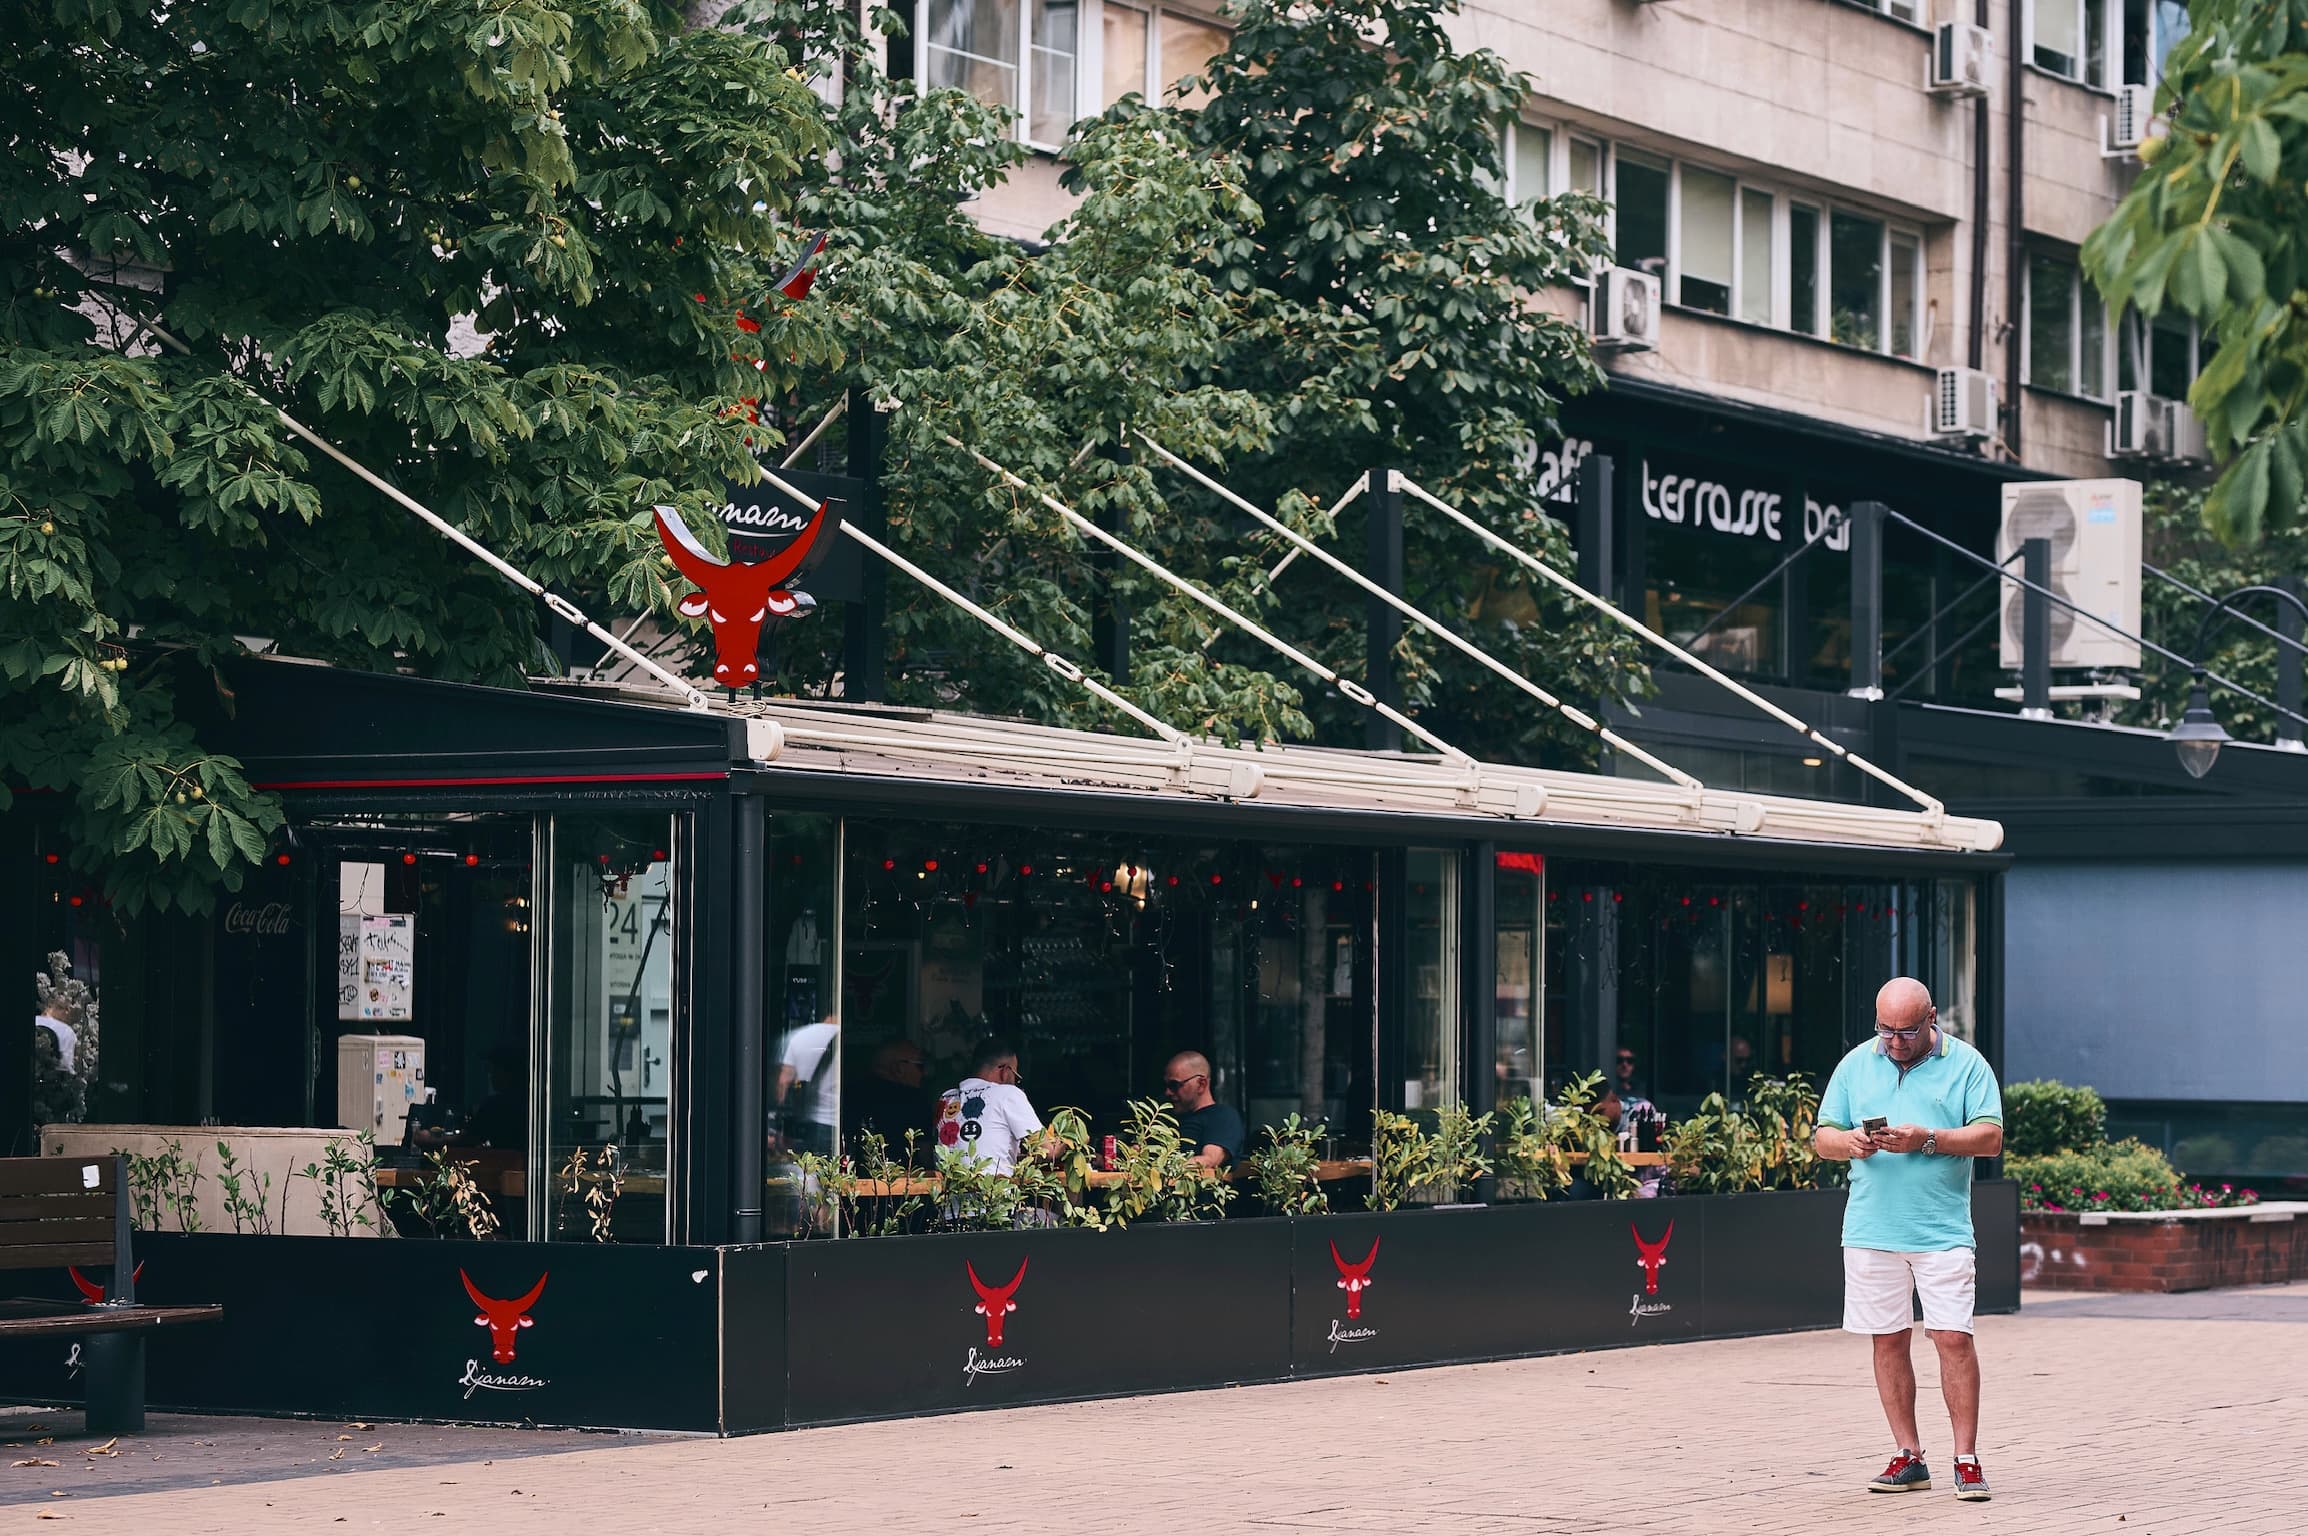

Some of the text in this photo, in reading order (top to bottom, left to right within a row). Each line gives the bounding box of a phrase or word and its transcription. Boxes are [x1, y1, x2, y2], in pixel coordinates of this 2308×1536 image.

[1642, 459, 1782, 541] terrasse
[1803, 491, 1851, 552] bar
[225, 901, 290, 935] Coca-Cola
